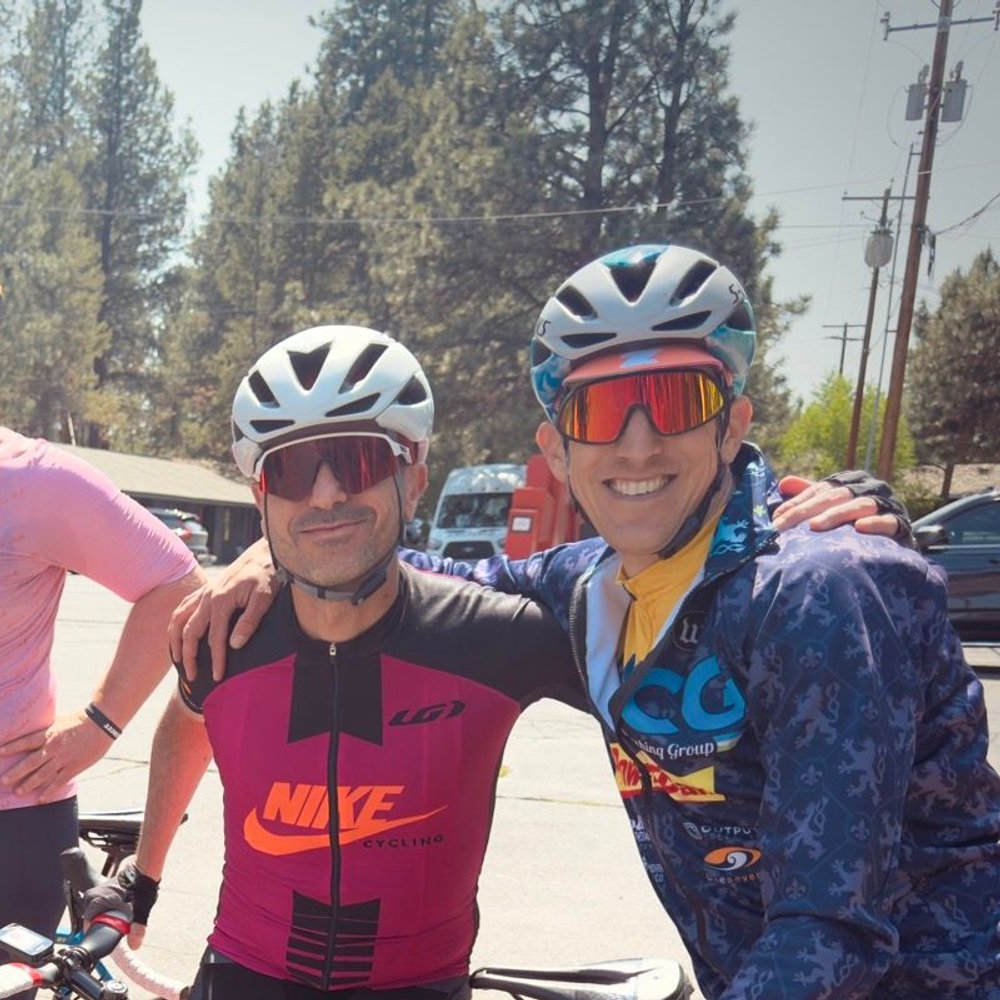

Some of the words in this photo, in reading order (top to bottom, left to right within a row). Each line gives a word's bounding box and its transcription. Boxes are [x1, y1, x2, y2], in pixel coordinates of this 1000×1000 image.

[667, 742, 714, 760] Group
[262, 781, 405, 829] NIKE
[364, 834, 445, 849] CYCLING
